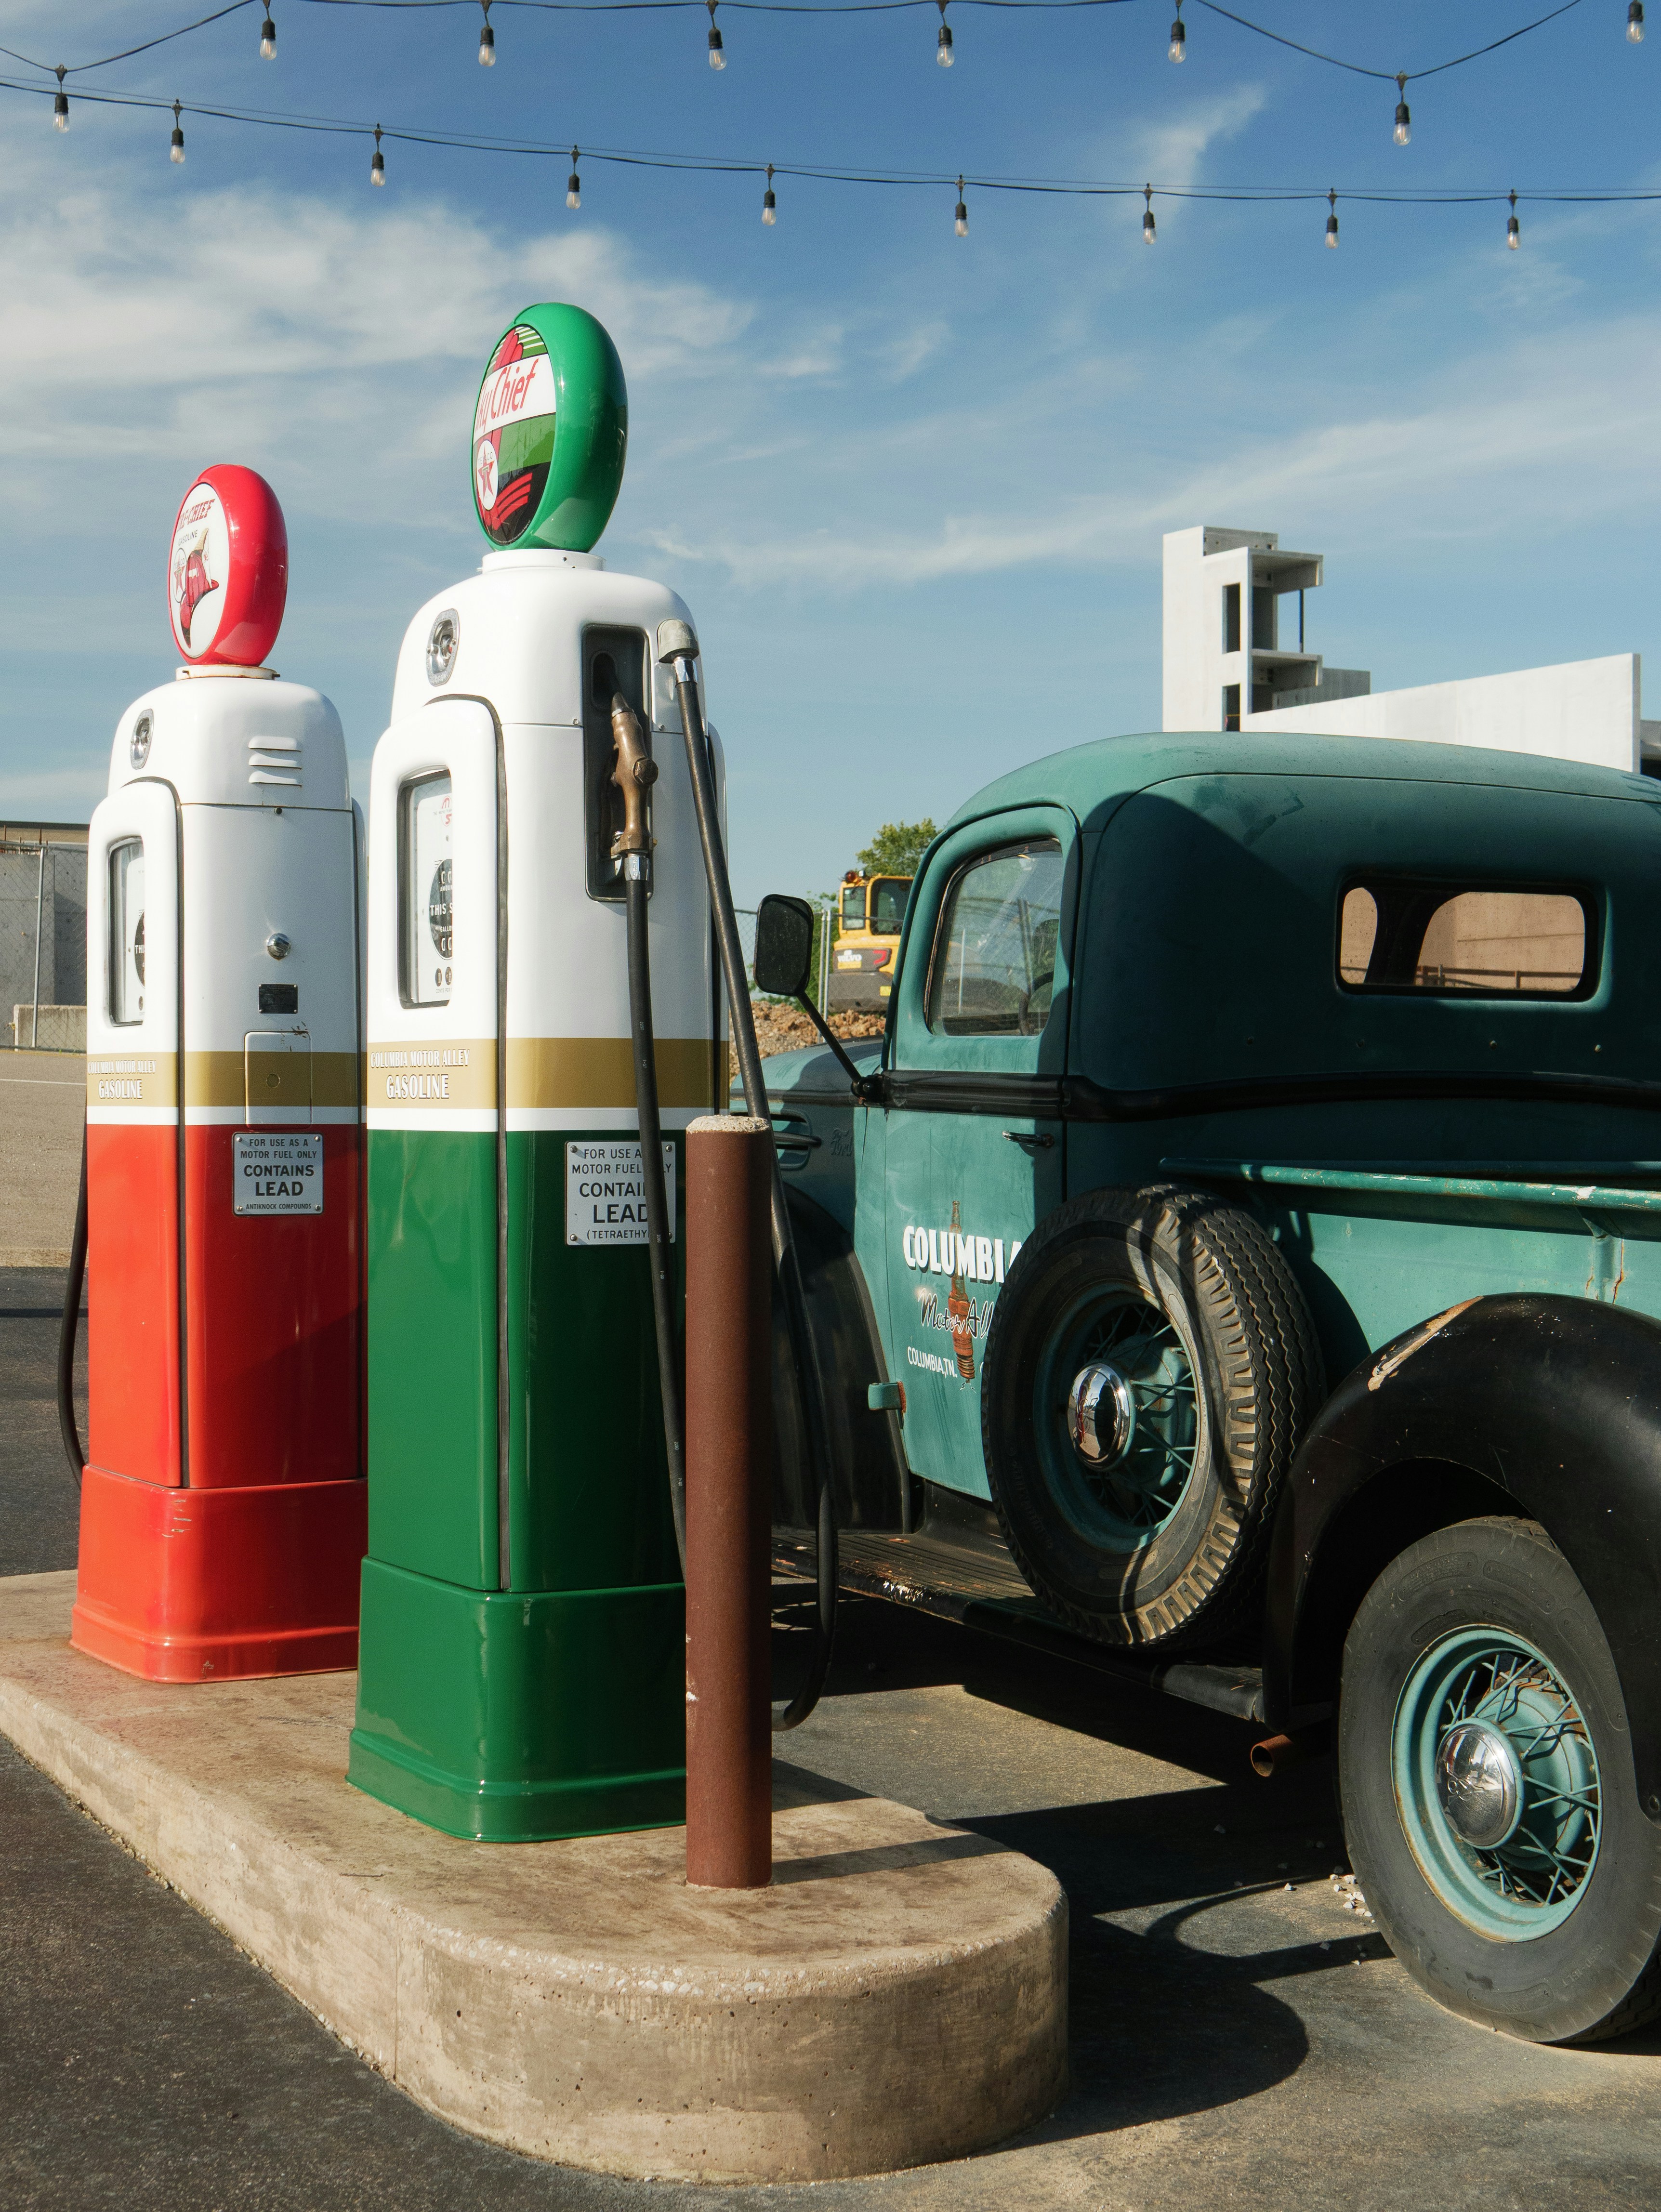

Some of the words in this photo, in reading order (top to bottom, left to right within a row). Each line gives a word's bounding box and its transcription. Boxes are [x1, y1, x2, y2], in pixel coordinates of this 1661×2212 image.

[491, 358, 539, 420] Chief
[178, 529, 198, 546] GASOLINE
[430, 903, 447, 916] THIS
[135, 944, 144, 954] THI
[371, 1051, 408, 1068] COLUMBIA
[409, 1050, 440, 1067] MOTOR
[442, 1049, 470, 1066] ALLEY
[88, 1061, 114, 1074] COLUMBIA
[116, 1060, 135, 1074] MOTOR
[137, 1060, 157, 1074] ALLEY
[99, 1079, 143, 1099] GASOLINE
[386, 1074, 449, 1099] GASOLINE
[240, 1150, 269, 1159] MOTOR
[274, 1150, 293, 1159] FUEL
[297, 1150, 317, 1159] ONLY
[584, 1149, 605, 1159] FOR
[610, 1149, 631, 1159] USE
[634, 1149, 642, 1158] A
[244, 1165, 314, 1177] CONTAINS
[572, 1164, 611, 1174] MOTOR
[616, 1164, 642, 1173] FUEL
[255, 1182, 303, 1196] LEAD
[580, 1182, 646, 1198] CONTAI
[593, 1204, 647, 1224] LEAD
[587, 1229, 649, 1240] (TETRAETHY
[917, 1288, 965, 1335] Motor
[965, 1297, 994, 1339] All
